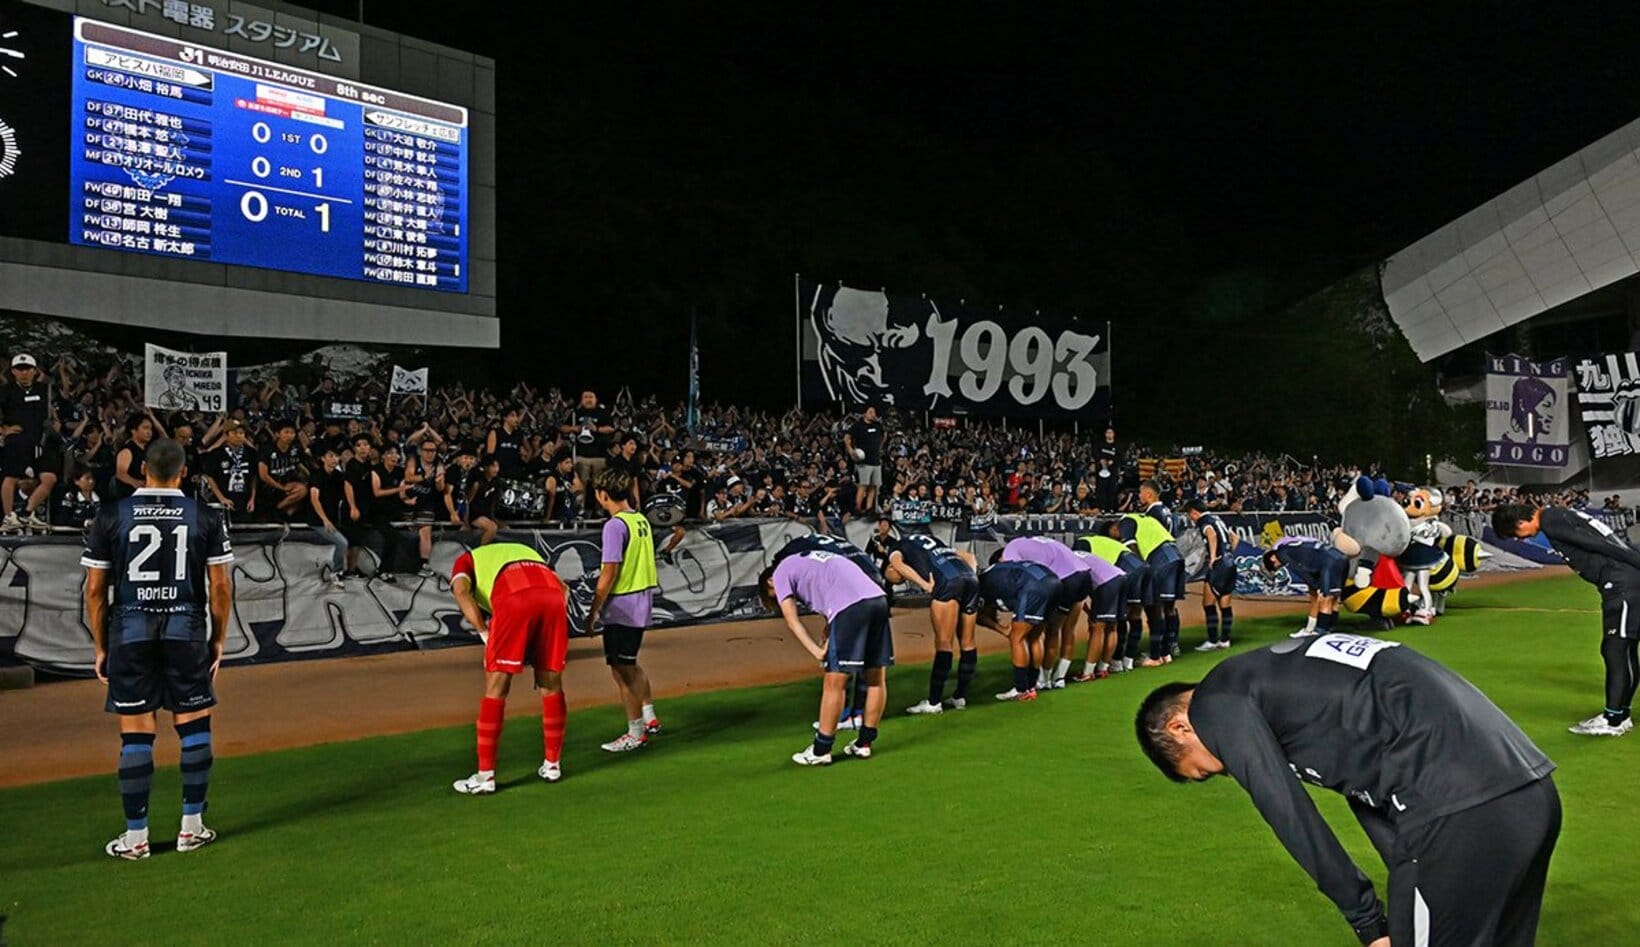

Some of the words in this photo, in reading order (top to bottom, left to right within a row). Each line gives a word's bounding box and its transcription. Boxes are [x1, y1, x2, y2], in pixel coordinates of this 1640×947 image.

[224, 14, 342, 62] スタジアム
[87, 70, 103, 80] GK
[251, 65, 263, 76] J1
[264, 68, 316, 88] LEAGUE
[336, 83, 359, 99] 8th
[362, 91, 385, 104] sec
[87, 102, 102, 112] DF
[124, 107, 153, 124] 田代
[87, 118, 102, 127] DF
[86, 133, 101, 143] DF
[252, 122, 271, 144] 0
[281, 133, 301, 144] 1ST
[309, 134, 328, 154] 0
[86, 150, 101, 160] MF
[123, 155, 173, 173] オリオール
[175, 161, 204, 178] ロメウ
[252, 157, 271, 178] 0
[280, 167, 301, 178] 2ND
[311, 168, 322, 188] 1
[85, 182, 101, 192] FW
[123, 187, 151, 202] 前田
[85, 199, 100, 208] DF
[240, 191, 268, 222] 0
[274, 206, 306, 219] TOTAL
[314, 203, 330, 232] 1
[84, 215, 100, 225] FW
[84, 231, 100, 241] FW
[122, 235, 150, 249] 名古
[154, 239, 195, 255] 新太郎
[923, 313, 1100, 410] 1993
[1493, 358, 1562, 375] KING
[185, 369, 213, 379] ICHIKA
[193, 382, 222, 391] MAEDA
[202, 395, 221, 410] 49
[1490, 445, 1563, 463] JOGO
[127, 525, 188, 581] 21
[137, 586, 177, 601] ROMEU
